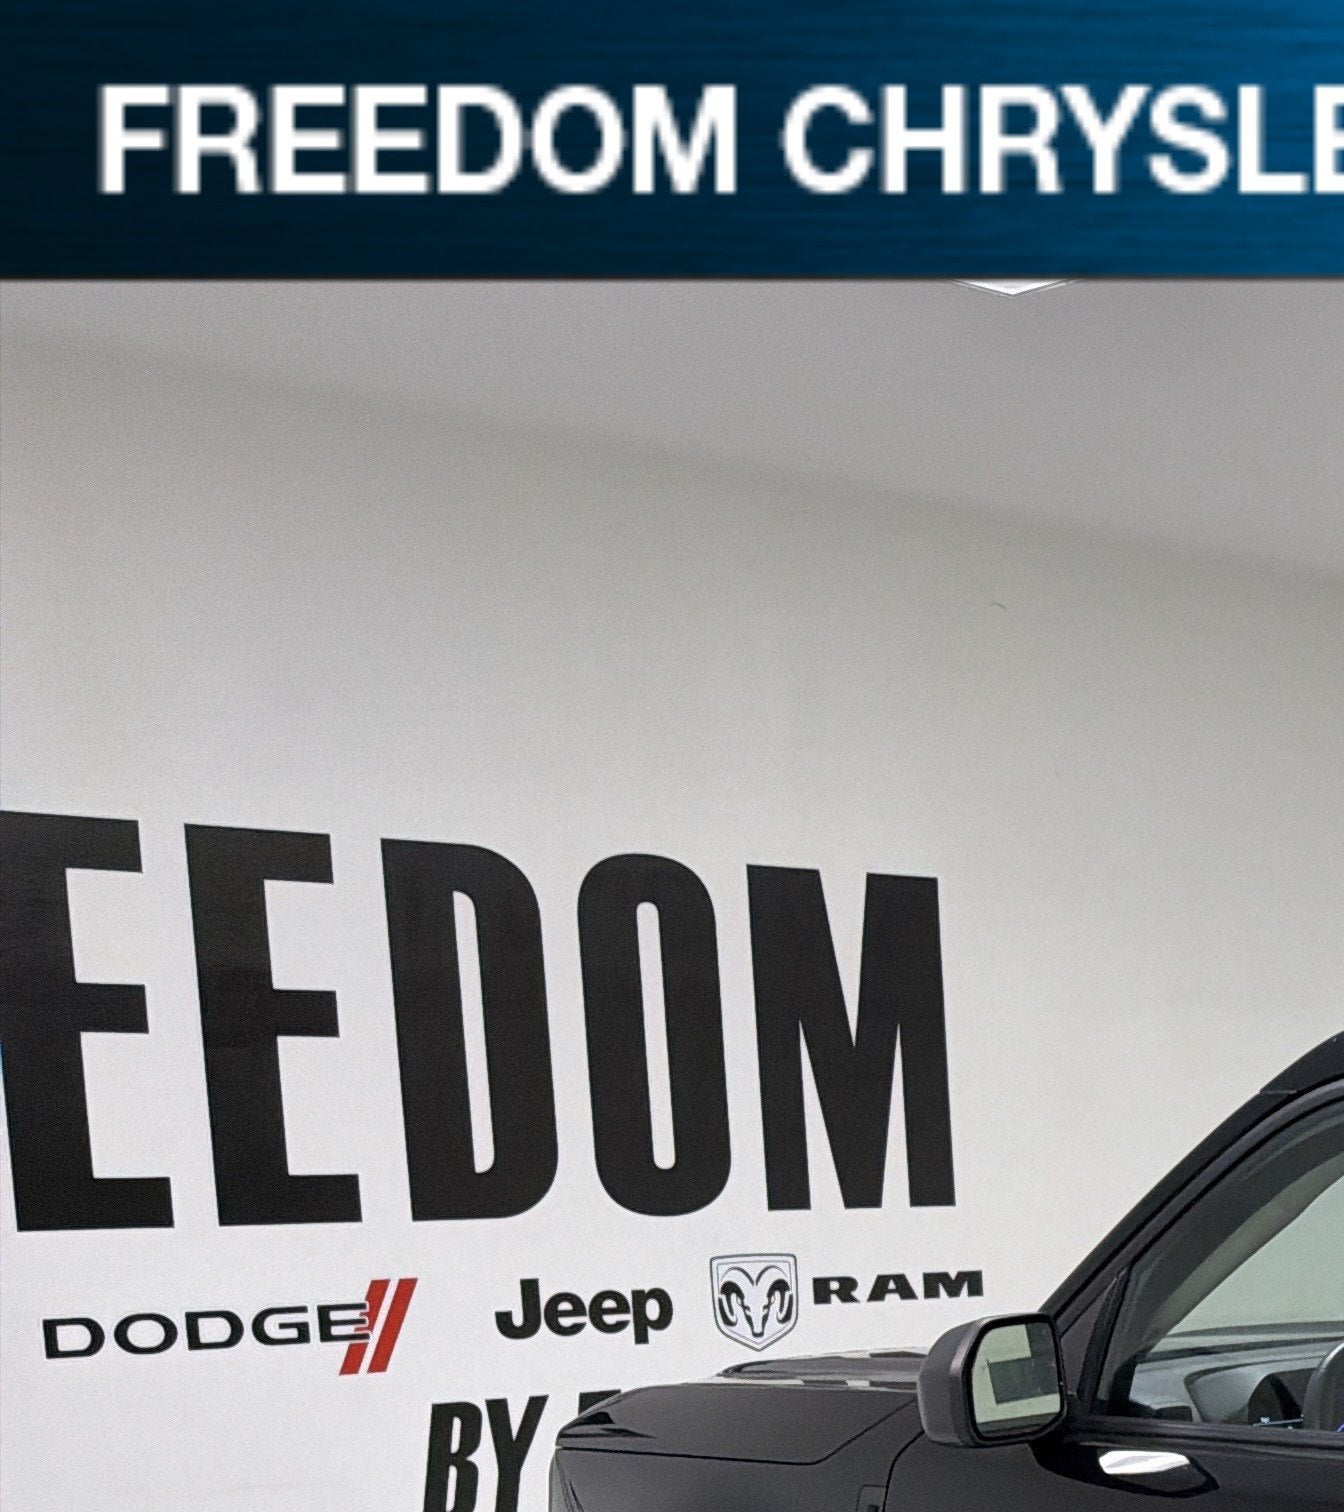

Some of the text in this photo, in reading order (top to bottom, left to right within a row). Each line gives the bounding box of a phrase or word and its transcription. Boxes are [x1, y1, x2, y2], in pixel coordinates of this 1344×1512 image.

[43, 1270, 983, 1360] DODGE Jeep RAM
